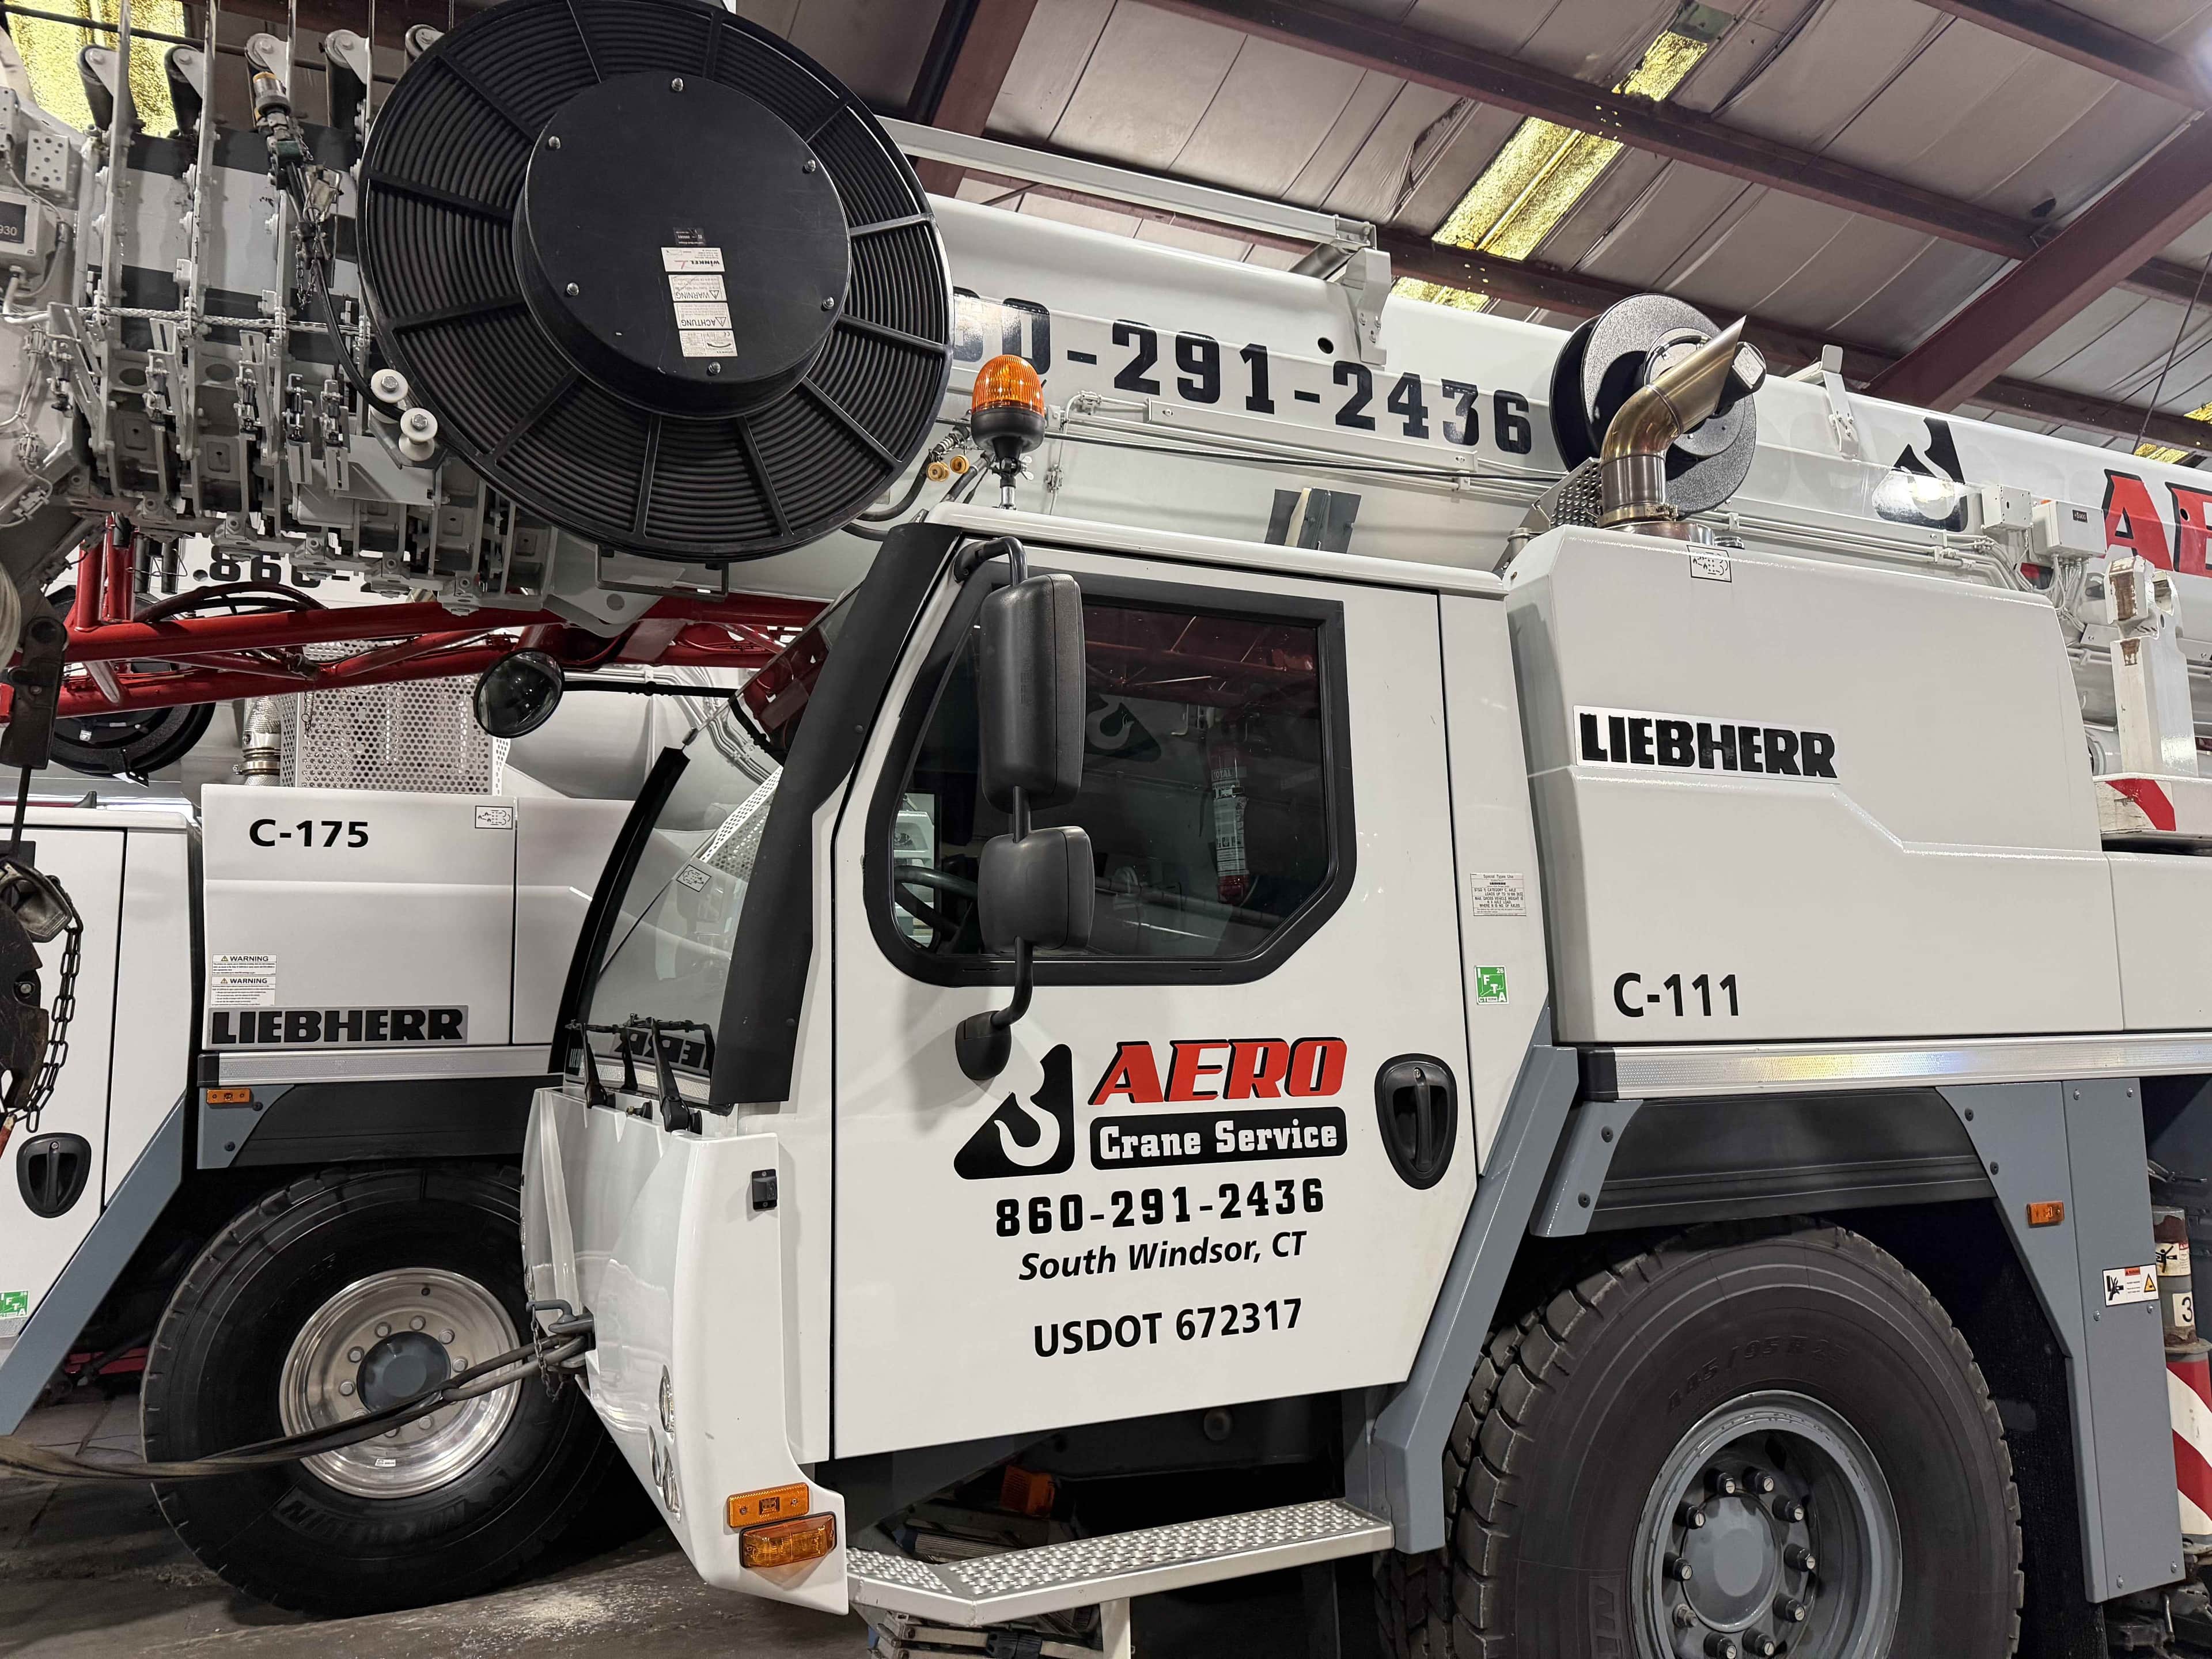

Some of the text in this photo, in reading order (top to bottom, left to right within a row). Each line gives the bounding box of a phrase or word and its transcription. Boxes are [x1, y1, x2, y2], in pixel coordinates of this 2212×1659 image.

[1580, 713, 1837, 778] LIEBHERR
[249, 819, 369, 848] C-175
[1613, 972, 1738, 1018] C-111
[212, 1009, 464, 1044] LIEBHERR
[1088, 1037, 1347, 1105] AERO
[1100, 1119, 1337, 1160] Crane Service
[996, 1178, 1324, 1237] 860-291-2436
[1018, 1230, 1307, 1281] South Windsor, CT
[1034, 1298, 1301, 1357] USDOT 672317
[2181, 1297, 2193, 1323] 3
